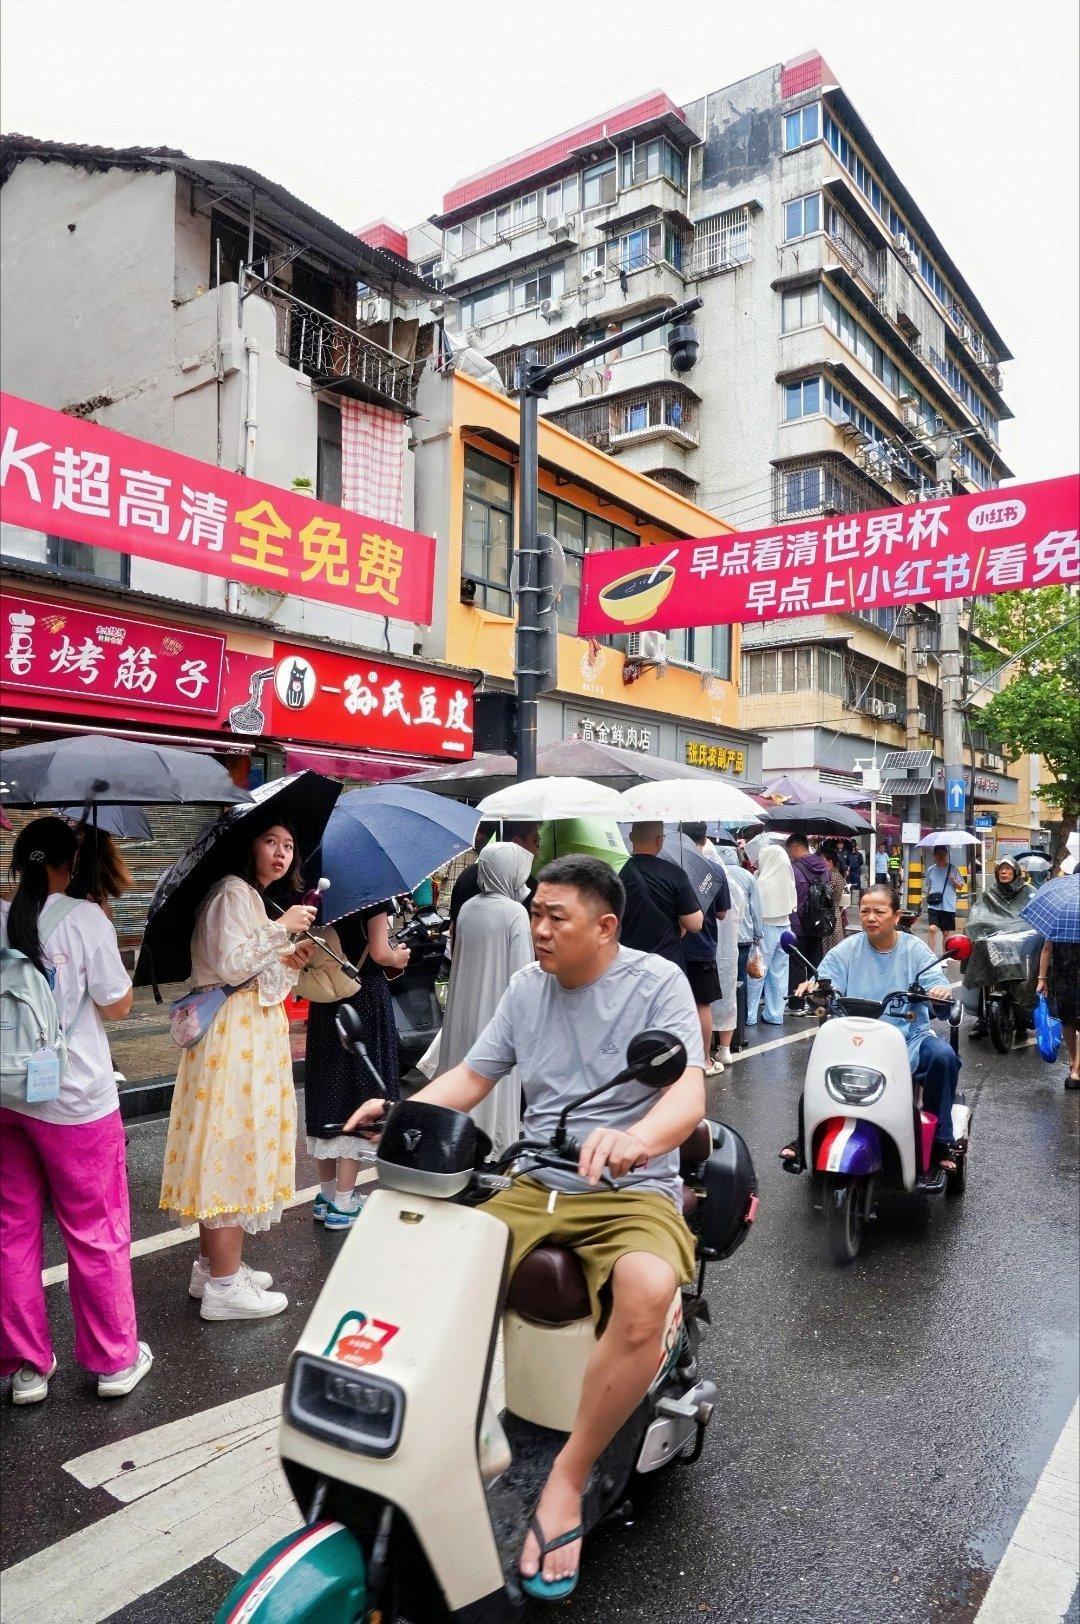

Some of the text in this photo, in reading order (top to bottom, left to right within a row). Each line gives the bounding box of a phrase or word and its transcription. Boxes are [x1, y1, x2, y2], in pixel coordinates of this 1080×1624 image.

[0, 427, 404, 606] K超高清全免费
[690, 505, 950, 579] 早点看清世界杯
[975, 506, 1018, 526] 小红书
